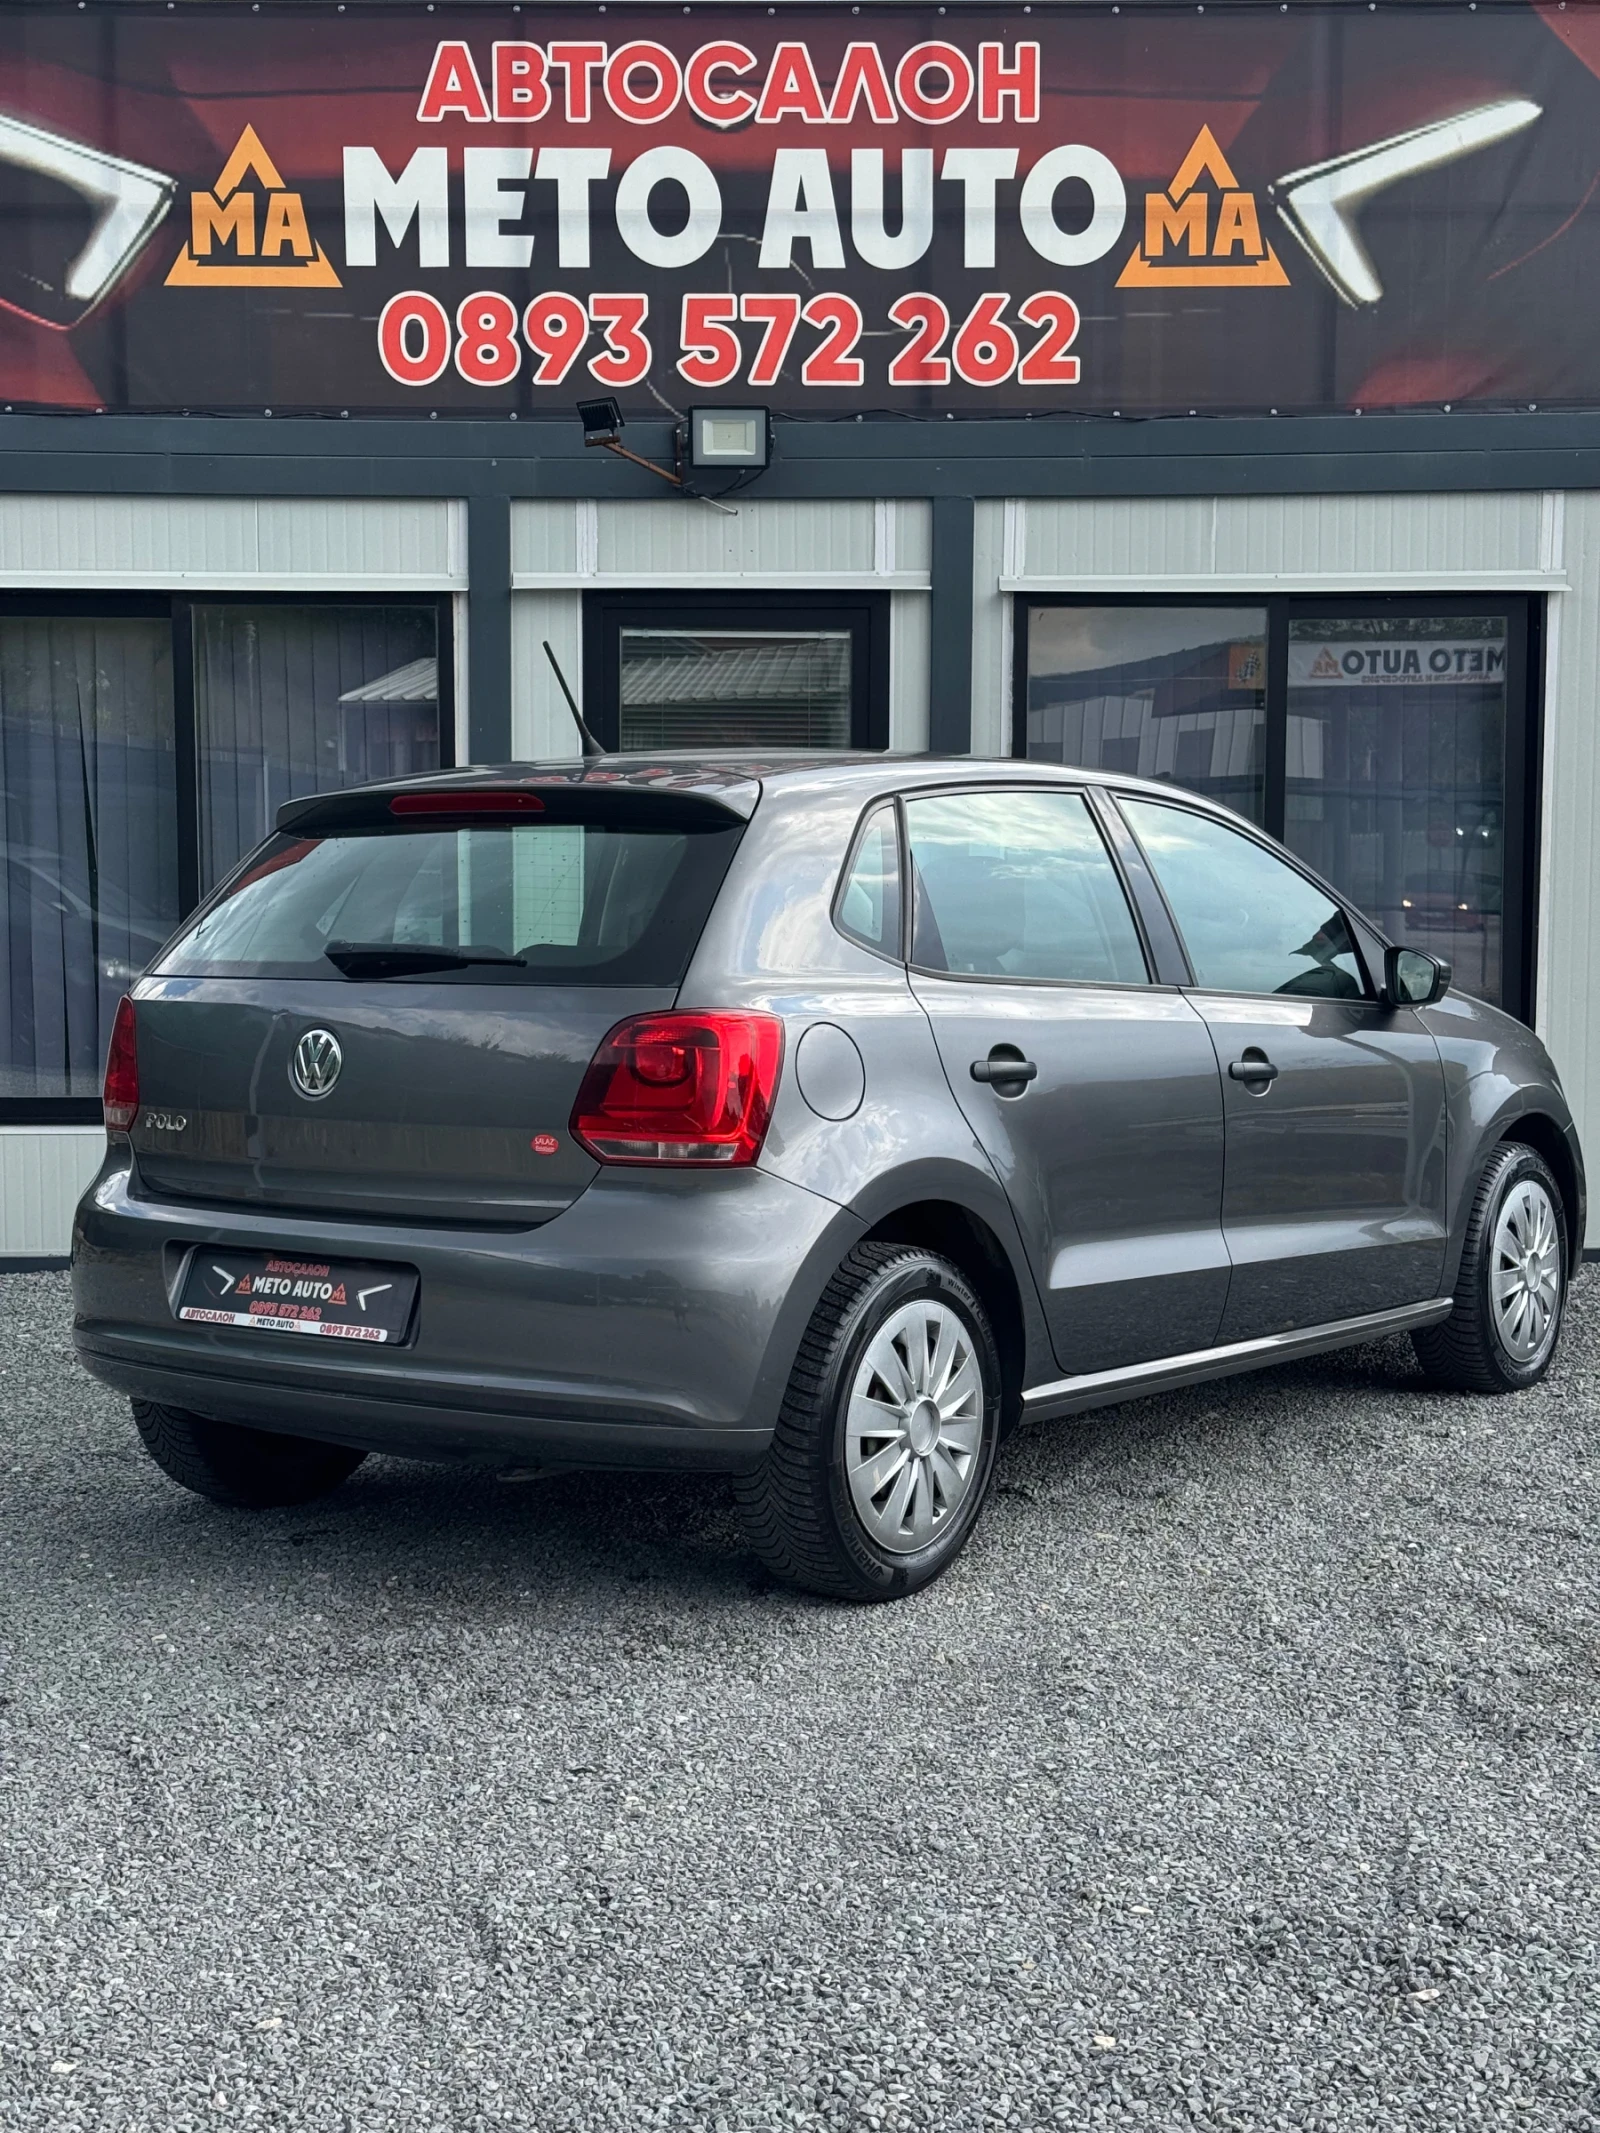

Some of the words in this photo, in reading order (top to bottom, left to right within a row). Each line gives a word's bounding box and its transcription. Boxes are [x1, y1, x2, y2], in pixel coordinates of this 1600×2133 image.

[416, 40, 1041, 125] АВТОСАЛОН
[191, 191, 312, 256] MA
[343, 146, 722, 269] METO
[758, 144, 1127, 270] AUTO
[1144, 191, 1264, 256] MA
[377, 290, 652, 387] 0893
[676, 291, 865, 387] 572
[888, 291, 1081, 387] 262
[145, 1112, 187, 1131] POLO
[252, 1275, 291, 1296] METO
[292, 1283, 332, 1300] AUTO
[249, 1300, 277, 1316] 0893
[277, 1303, 300, 1318] 572
[300, 1306, 322, 1321] 262
[256, 1316, 275, 1327] METO
[275, 1319, 295, 1329] AUTO
[319, 1323, 342, 1335] 0893
[342, 1326, 361, 1338] 572
[361, 1328, 381, 1340] 262
